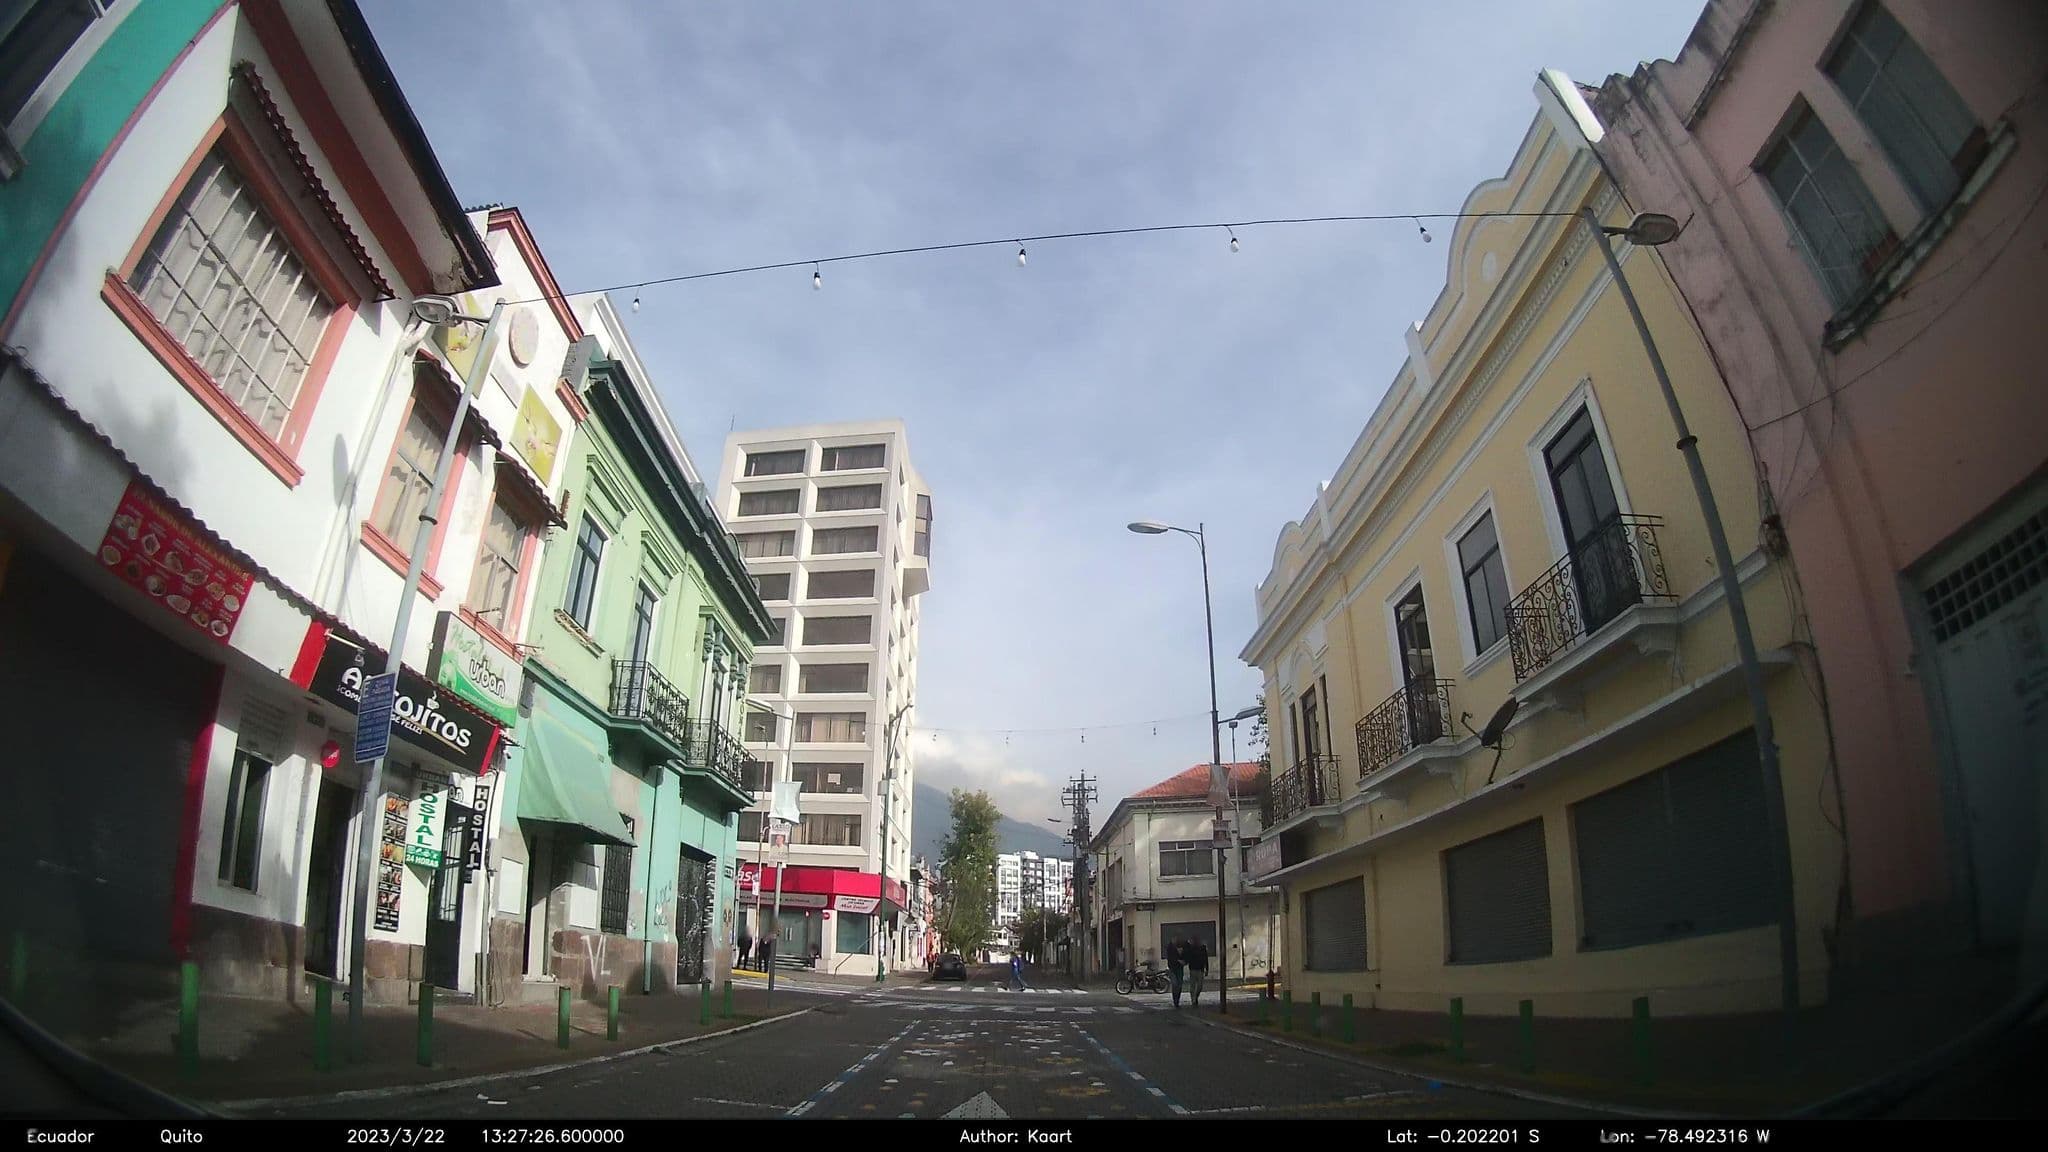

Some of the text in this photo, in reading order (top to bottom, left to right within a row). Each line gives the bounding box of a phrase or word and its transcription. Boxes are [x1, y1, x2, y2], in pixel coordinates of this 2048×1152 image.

[341, 667, 473, 748] AOJITOS
[469, 655, 506, 699] urban
[416, 781, 439, 846] HOSTAL
[466, 786, 490, 868] HOSTAL
[405, 854, 439, 868] 24 HORAS
